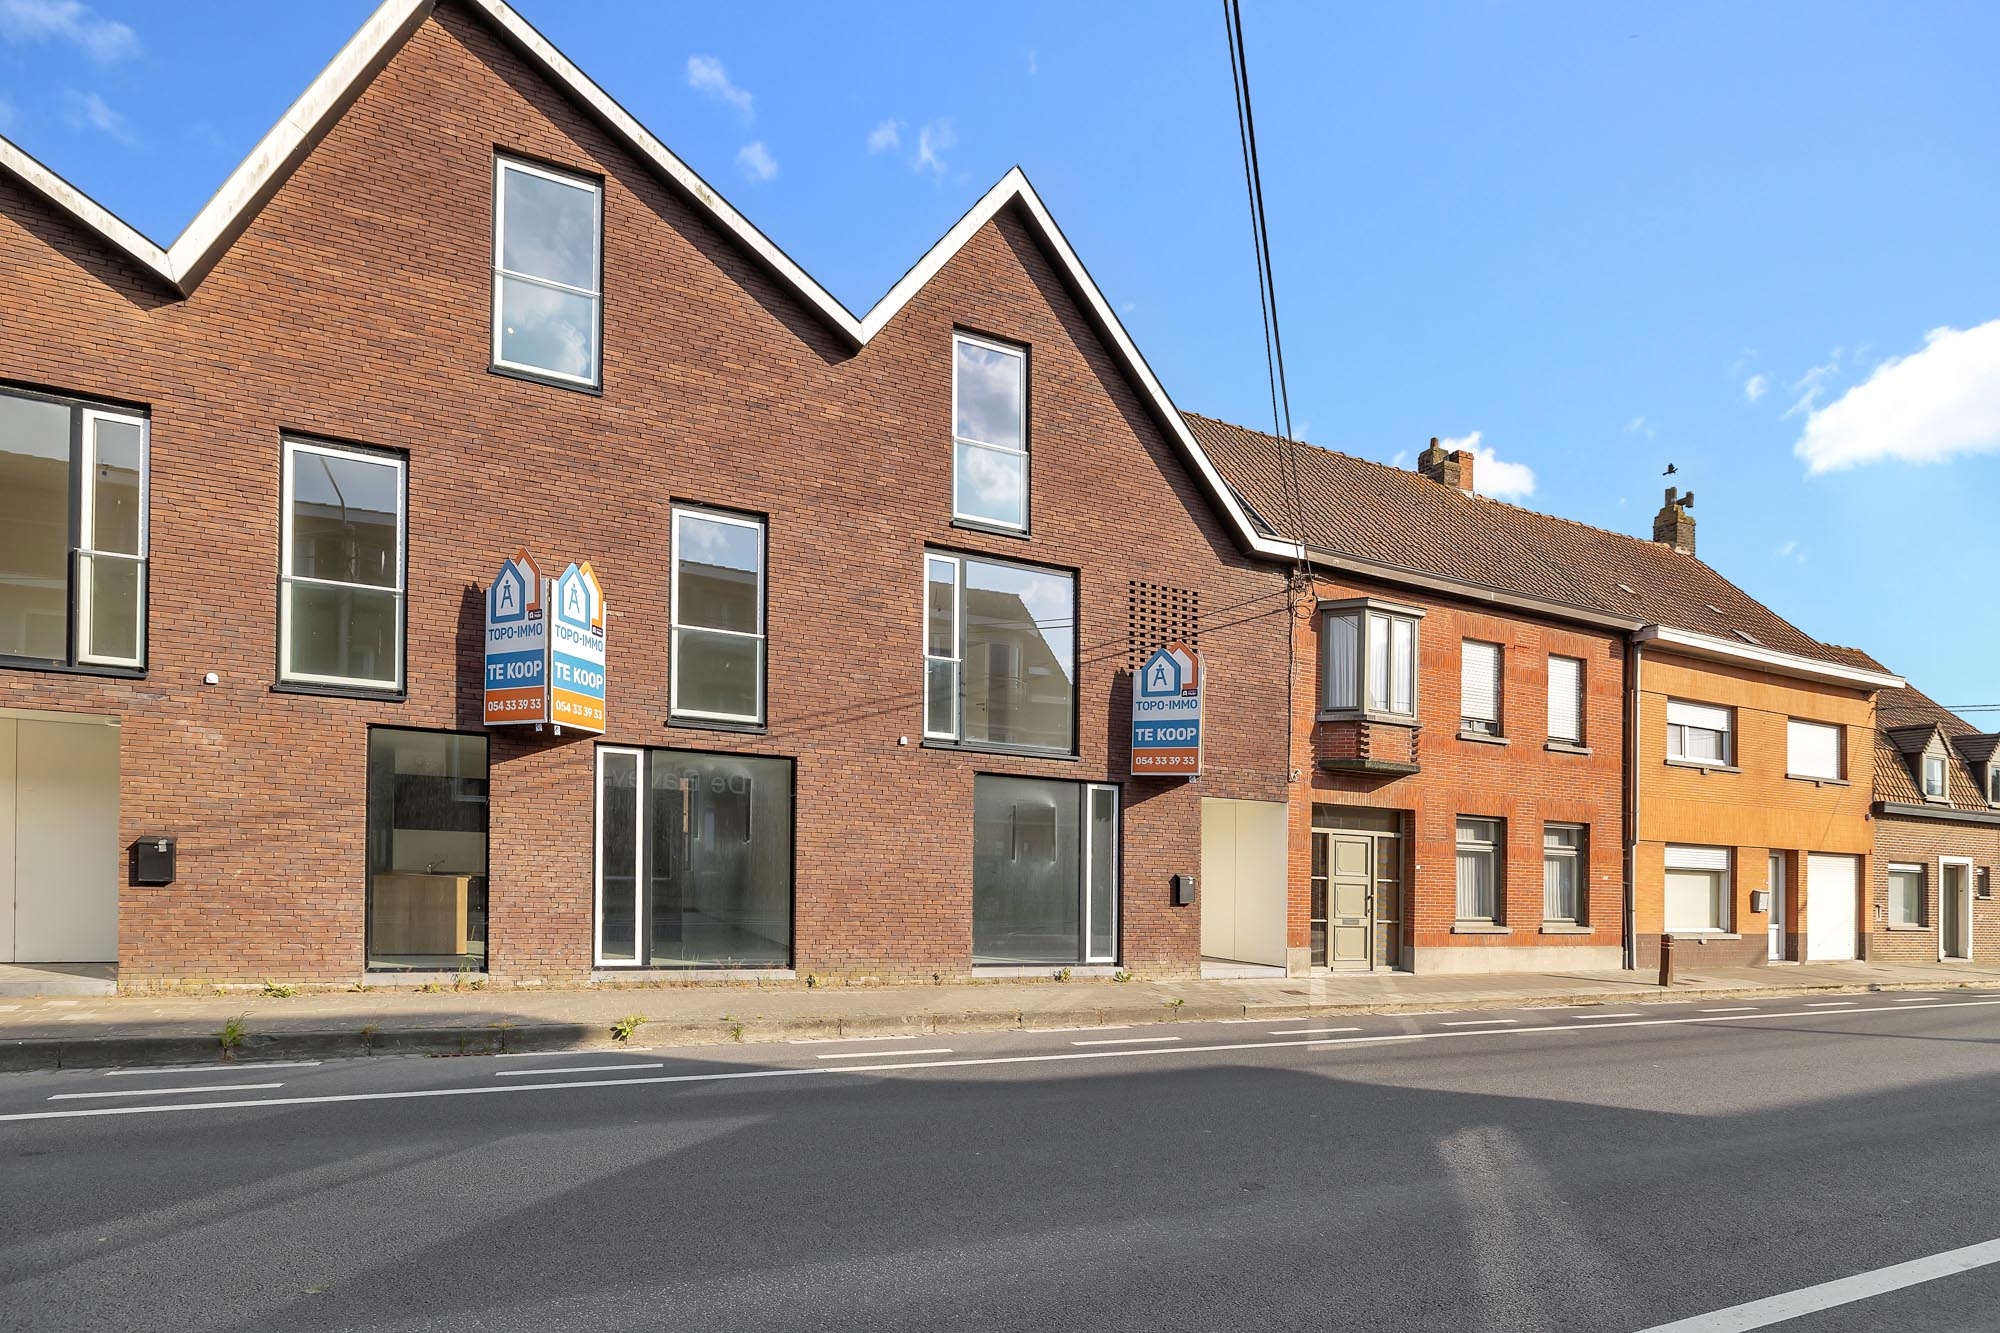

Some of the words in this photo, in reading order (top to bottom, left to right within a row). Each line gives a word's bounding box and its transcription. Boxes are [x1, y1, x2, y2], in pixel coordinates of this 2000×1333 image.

[488, 623, 543, 641] TOPO-IMMO
[554, 624, 604, 653] TOPO-IMMO
[487, 664, 504, 680] TE
[507, 660, 543, 679] KOOP
[554, 662, 571, 682] TE
[573, 669, 603, 689] KOOP
[487, 701, 504, 712] 054
[505, 700, 517, 711] 33
[518, 700, 528, 710] 39
[530, 699, 542, 710] 33
[555, 701, 571, 713] 054
[572, 704, 583, 716] 33
[583, 707, 593, 718] 39
[593, 709, 603, 720] 33
[1135, 699, 1198, 711] TOPO-IMMO
[1135, 728, 1154, 742] TE
[1157, 727, 1197, 741] KOOP
[1135, 756, 1153, 765] 054
[1155, 756, 1168, 765] 33
[1168, 756, 1180, 765] 39
[1182, 756, 1195, 765] 33
